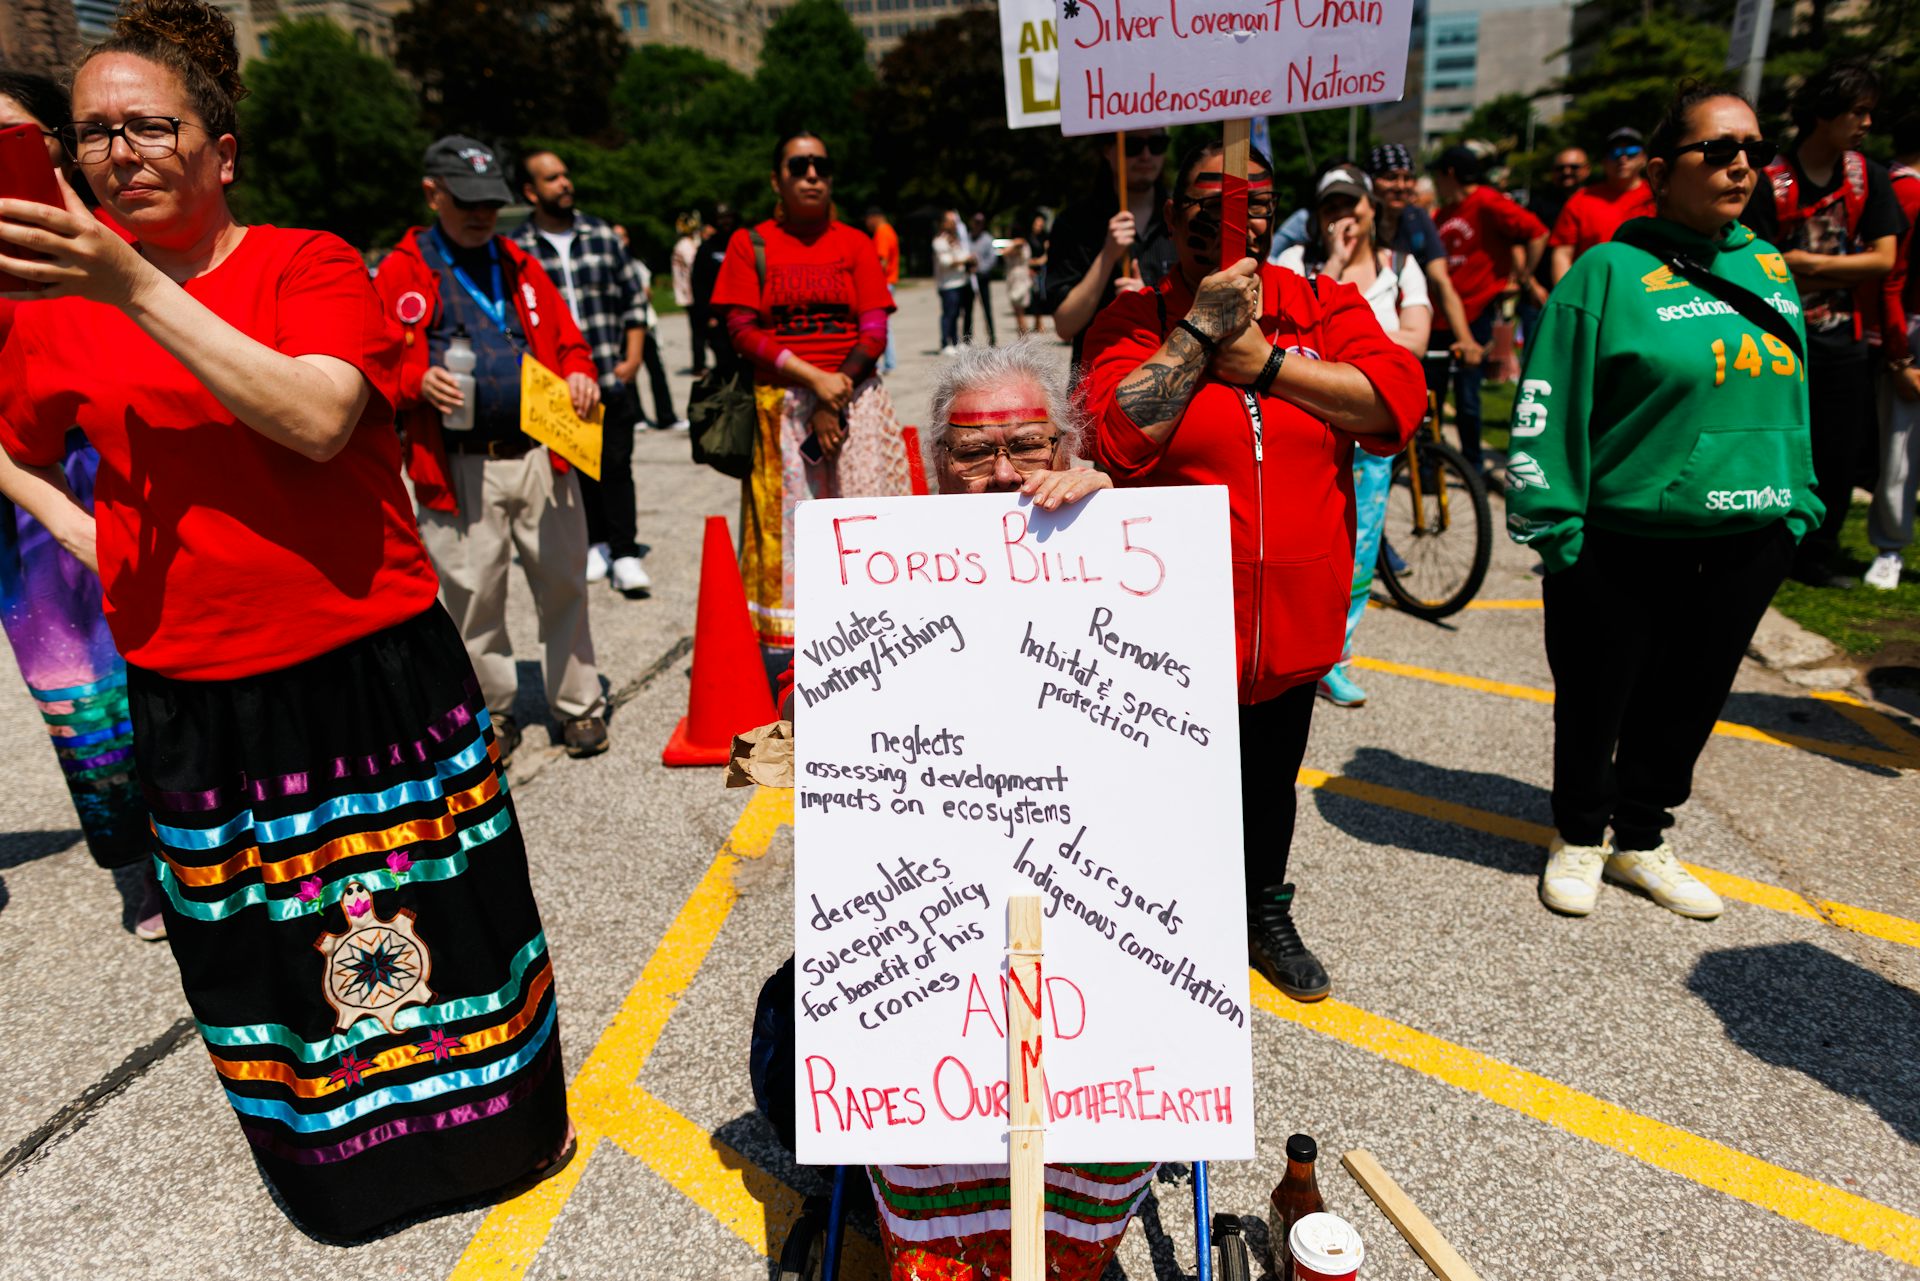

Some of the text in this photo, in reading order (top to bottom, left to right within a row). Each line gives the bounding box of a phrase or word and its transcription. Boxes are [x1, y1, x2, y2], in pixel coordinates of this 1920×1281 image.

[1074, 0, 1165, 48] Silver
[1287, 54, 1386, 104] Nations
[832, 511, 1166, 597] FORD'S BILL 5
[797, 614, 966, 709] hunting/fishing
[1020, 621, 1099, 687] habitat
[1123, 691, 1211, 747] species
[1089, 607, 1191, 688] Removes
[872, 724, 965, 764] neglects
[1037, 682, 1149, 748] protection
[801, 787, 1071, 843] impacts on ecosystems
[806, 762, 1069, 798] assessing development
[811, 857, 951, 932] deregulates
[1059, 826, 1184, 935] disregards
[802, 880, 990, 986] sweeping policy
[1013, 838, 1244, 1029] Indigenous consultation
[801, 923, 985, 1022] for benefit of his
[859, 972, 960, 1030] cronies
[962, 962, 1086, 1041] AND
[805, 1055, 927, 1133] RAPES
[933, 1056, 1010, 1121] OUR
